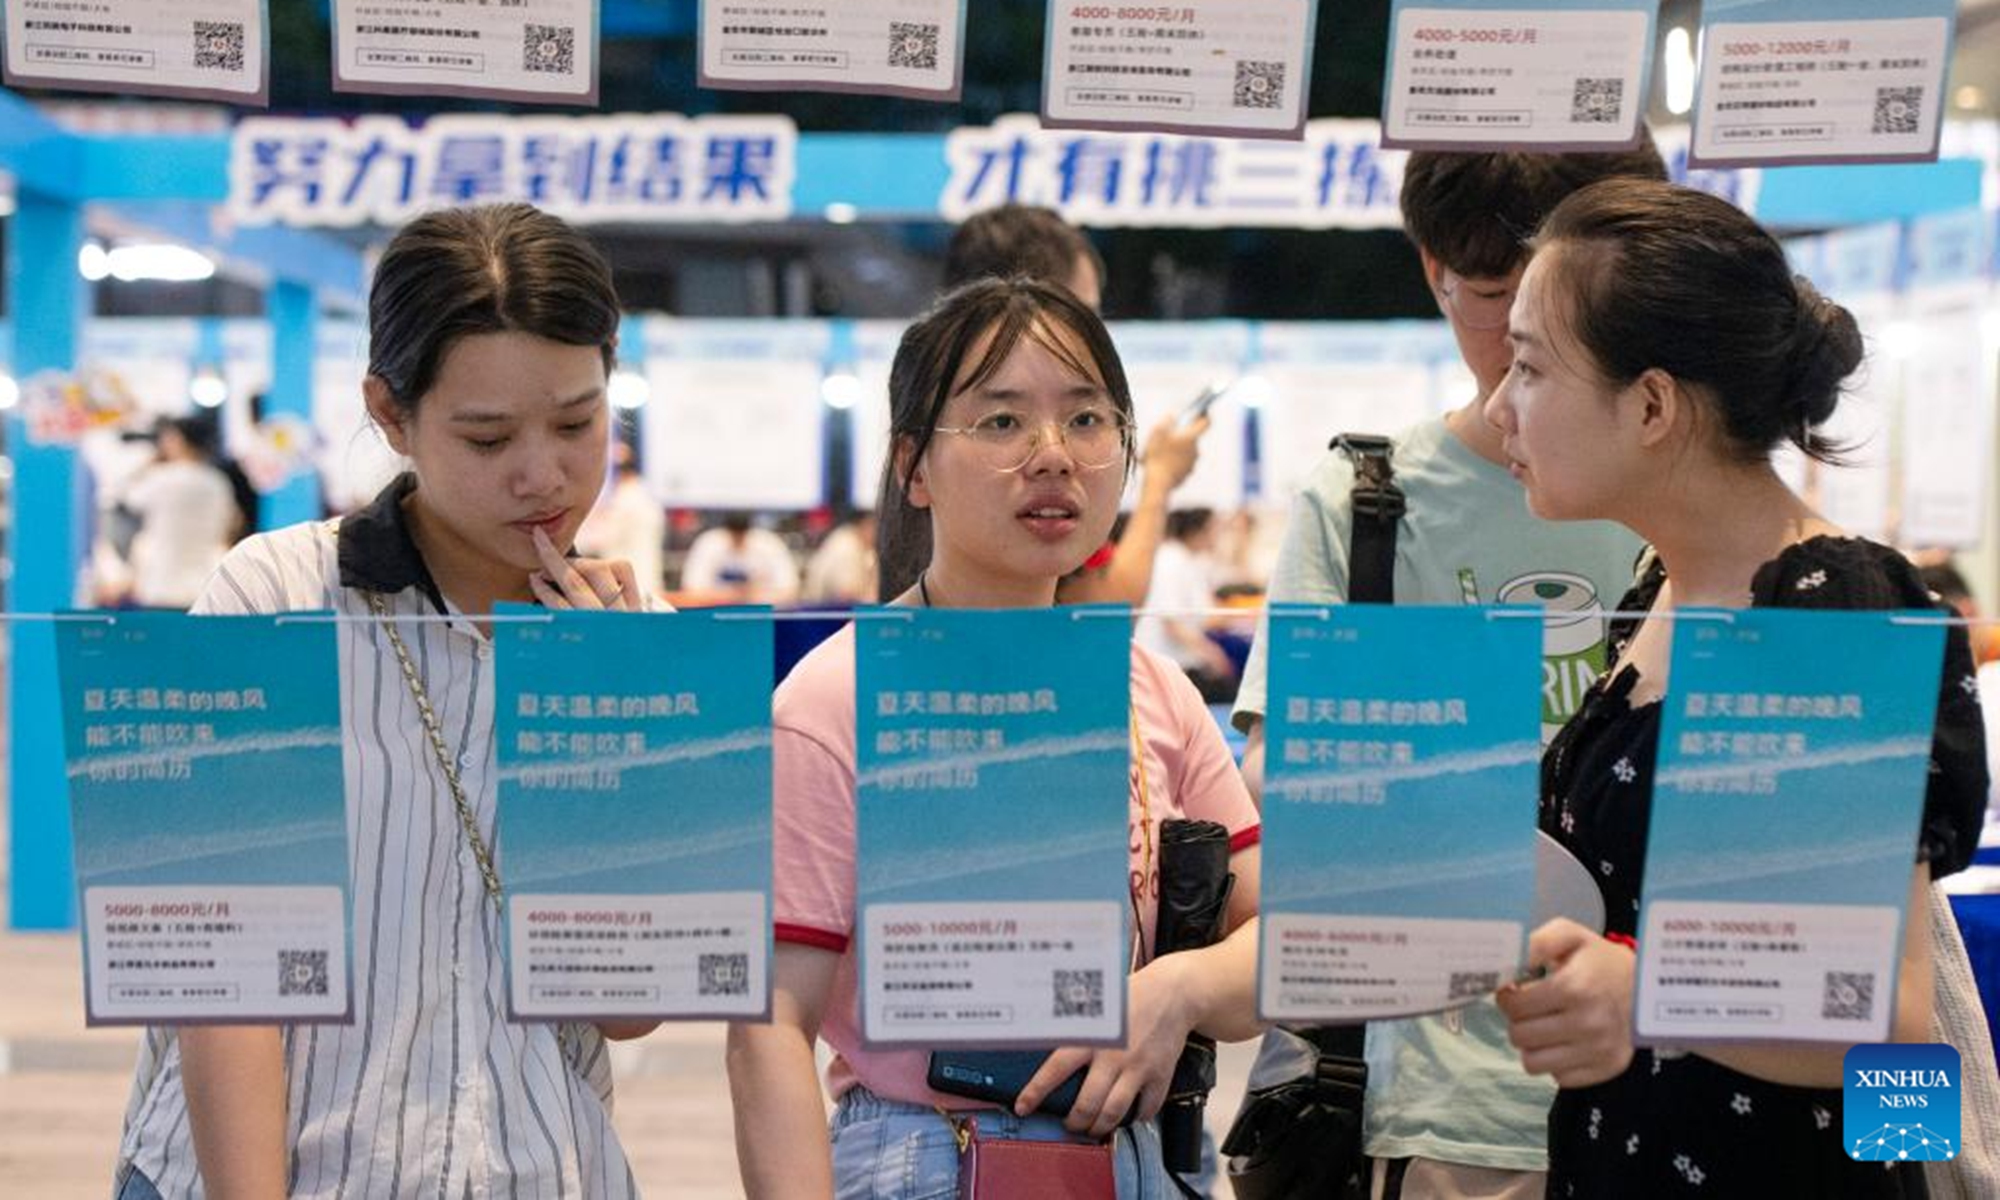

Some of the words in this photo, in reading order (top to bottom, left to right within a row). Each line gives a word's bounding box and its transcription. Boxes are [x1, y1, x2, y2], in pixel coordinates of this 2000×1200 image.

[251, 134, 777, 203] 努力拿到结果
[84, 687, 267, 713] 夏天温柔的晚风
[517, 692, 699, 718] 夏天温柔的晚风
[876, 688, 1058, 717] 夏天温柔的晚风
[1286, 697, 1467, 725] 夏天温柔的晚风
[1686, 693, 1862, 719] 夏天温柔的晚风
[85, 723, 216, 747] 能不能吹来
[517, 731, 646, 755] 能不能吹来
[876, 728, 1004, 754] 能不能吹来
[1680, 732, 1805, 755] 能不能吹来
[1284, 738, 1414, 764] 能不能吹来
